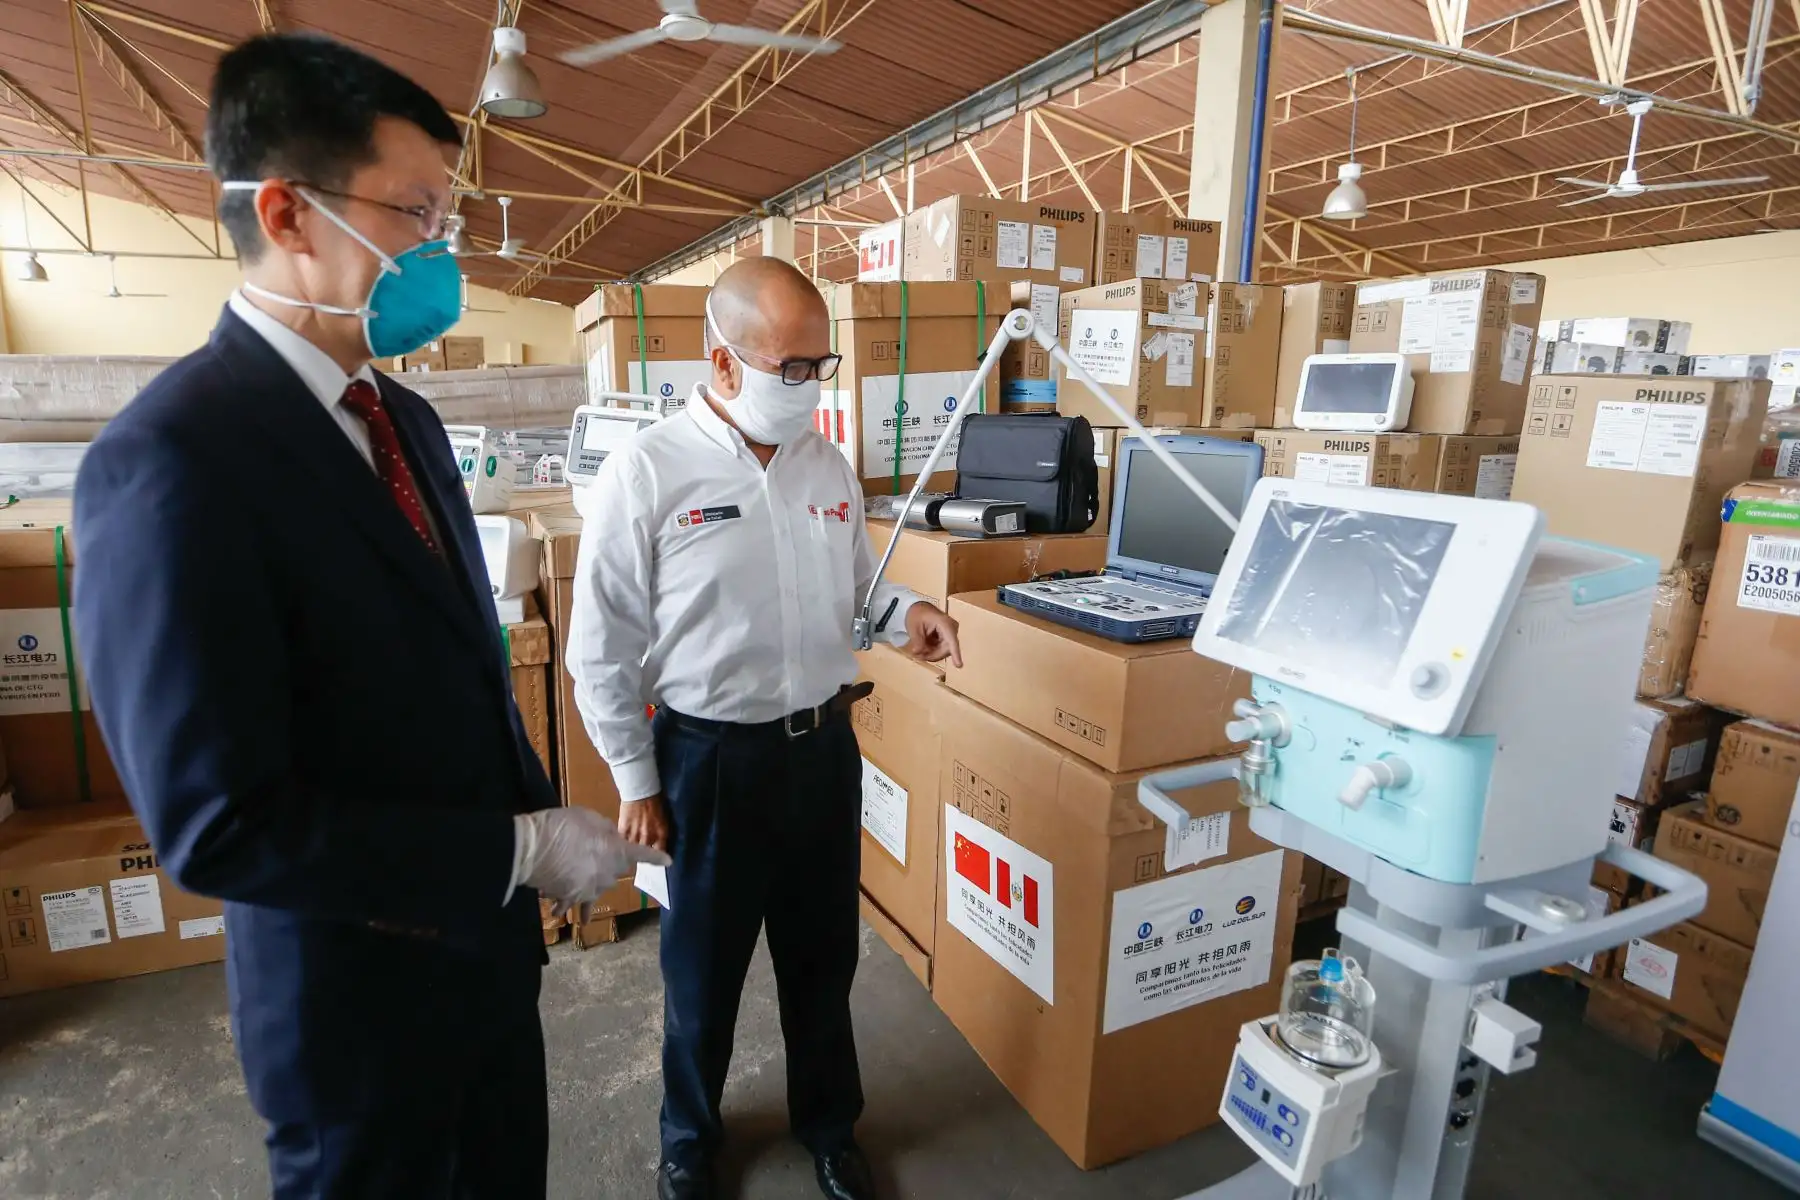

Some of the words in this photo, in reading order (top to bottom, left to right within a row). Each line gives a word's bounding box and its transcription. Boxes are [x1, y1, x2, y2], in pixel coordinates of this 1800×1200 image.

[1040, 206, 1086, 224] PHILIPS
[1174, 220, 1213, 233] PHILIPS
[1105, 286, 1136, 300] PHILIPS
[1430, 278, 1482, 293] PHILIPS
[1636, 388, 1706, 404] PHILIPS
[1324, 440, 1370, 453] PHILIPS
[3, 652, 57, 664] 长江电力
[120, 856, 160, 872] PHI
[43, 892, 76, 902] PHILIPS
[961, 888, 993, 920] 同享阳光
[998, 916, 1036, 950] 共担风雨
[1222, 920, 1236, 928] LUZ
[1237, 916, 1251, 924] DEL
[1251, 912, 1266, 920] SUR
[1124, 936, 1164, 956] 中国三峡
[1176, 923, 1213, 940] 长江电力
[1135, 958, 1190, 984] 同享阳光
[1198, 940, 1251, 965] 共担风雨
[1139, 976, 1182, 994] Compartimos
[1183, 970, 1199, 981] tanto
[1201, 966, 1211, 975] las
[1212, 957, 1247, 972] felicidades
[1144, 991, 1162, 1001] como
[1162, 987, 1172, 996] las
[1174, 975, 1211, 992] dificultades
[1220, 969, 1227, 977] la
[1228, 965, 1242, 975] vida
